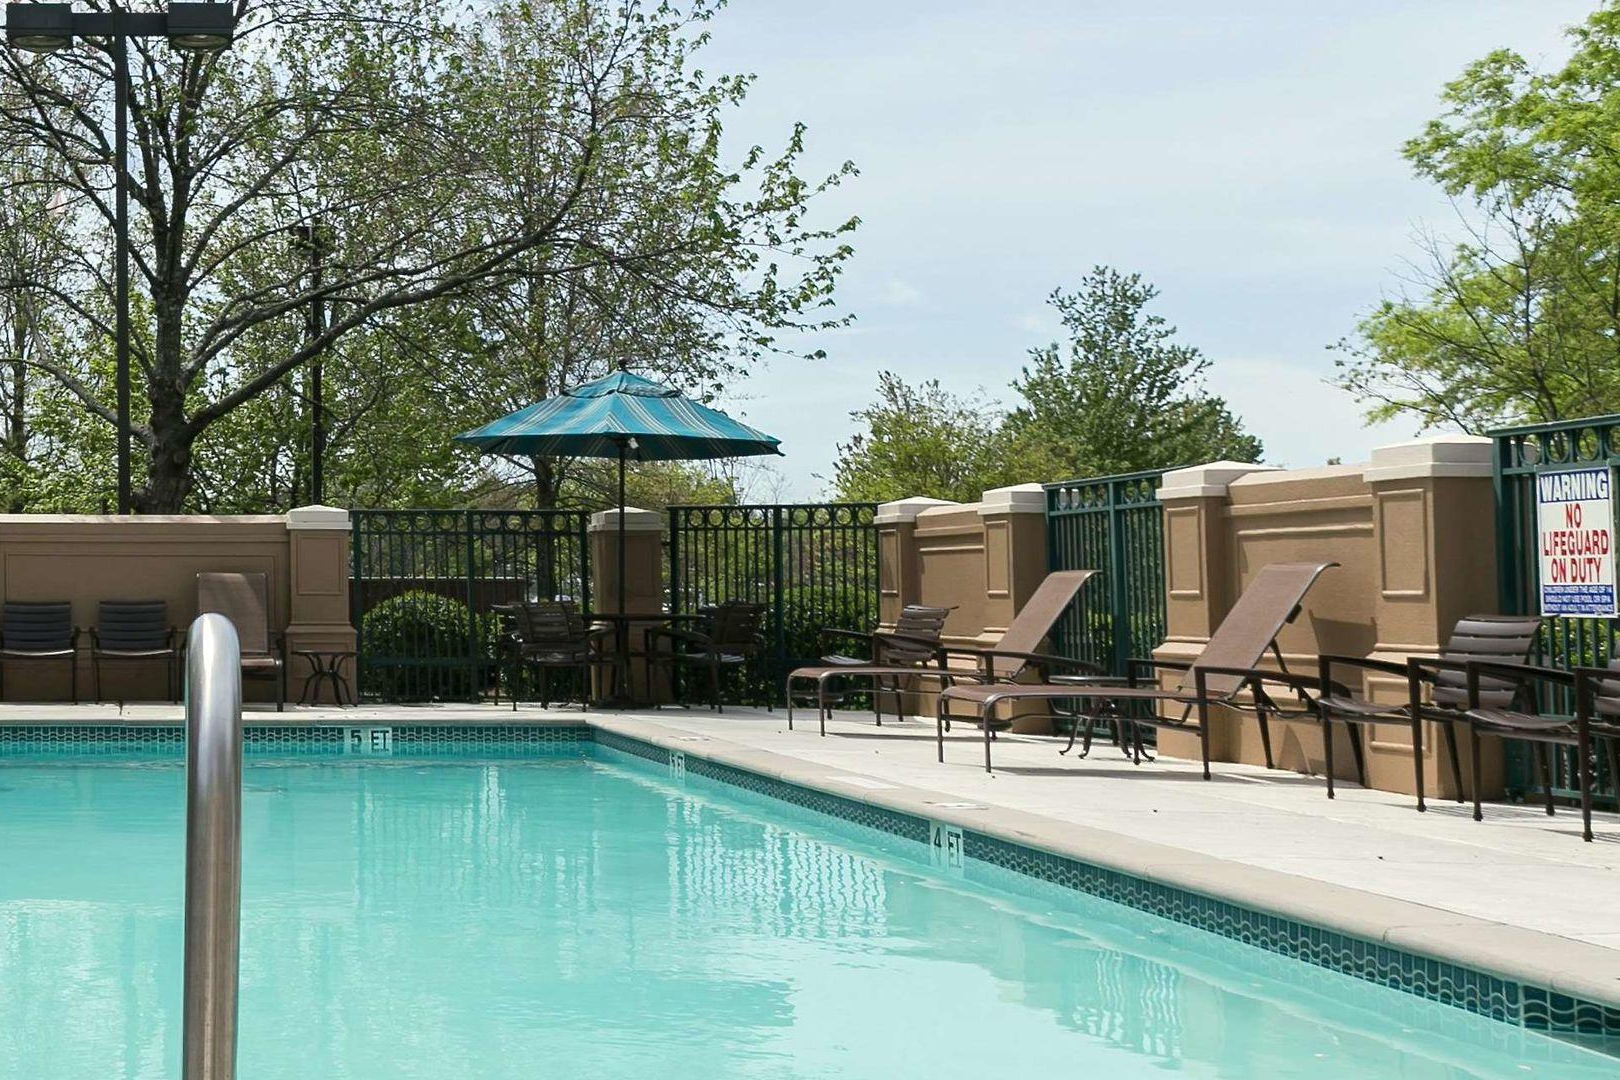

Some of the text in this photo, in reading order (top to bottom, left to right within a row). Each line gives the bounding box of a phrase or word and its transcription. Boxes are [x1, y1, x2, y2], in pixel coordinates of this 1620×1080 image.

[1540, 471, 1609, 502] WARNING
[1565, 503, 1582, 528] NO
[1543, 529, 1609, 557] LIFEGUARD
[1551, 557, 1602, 583] ON DUTY
